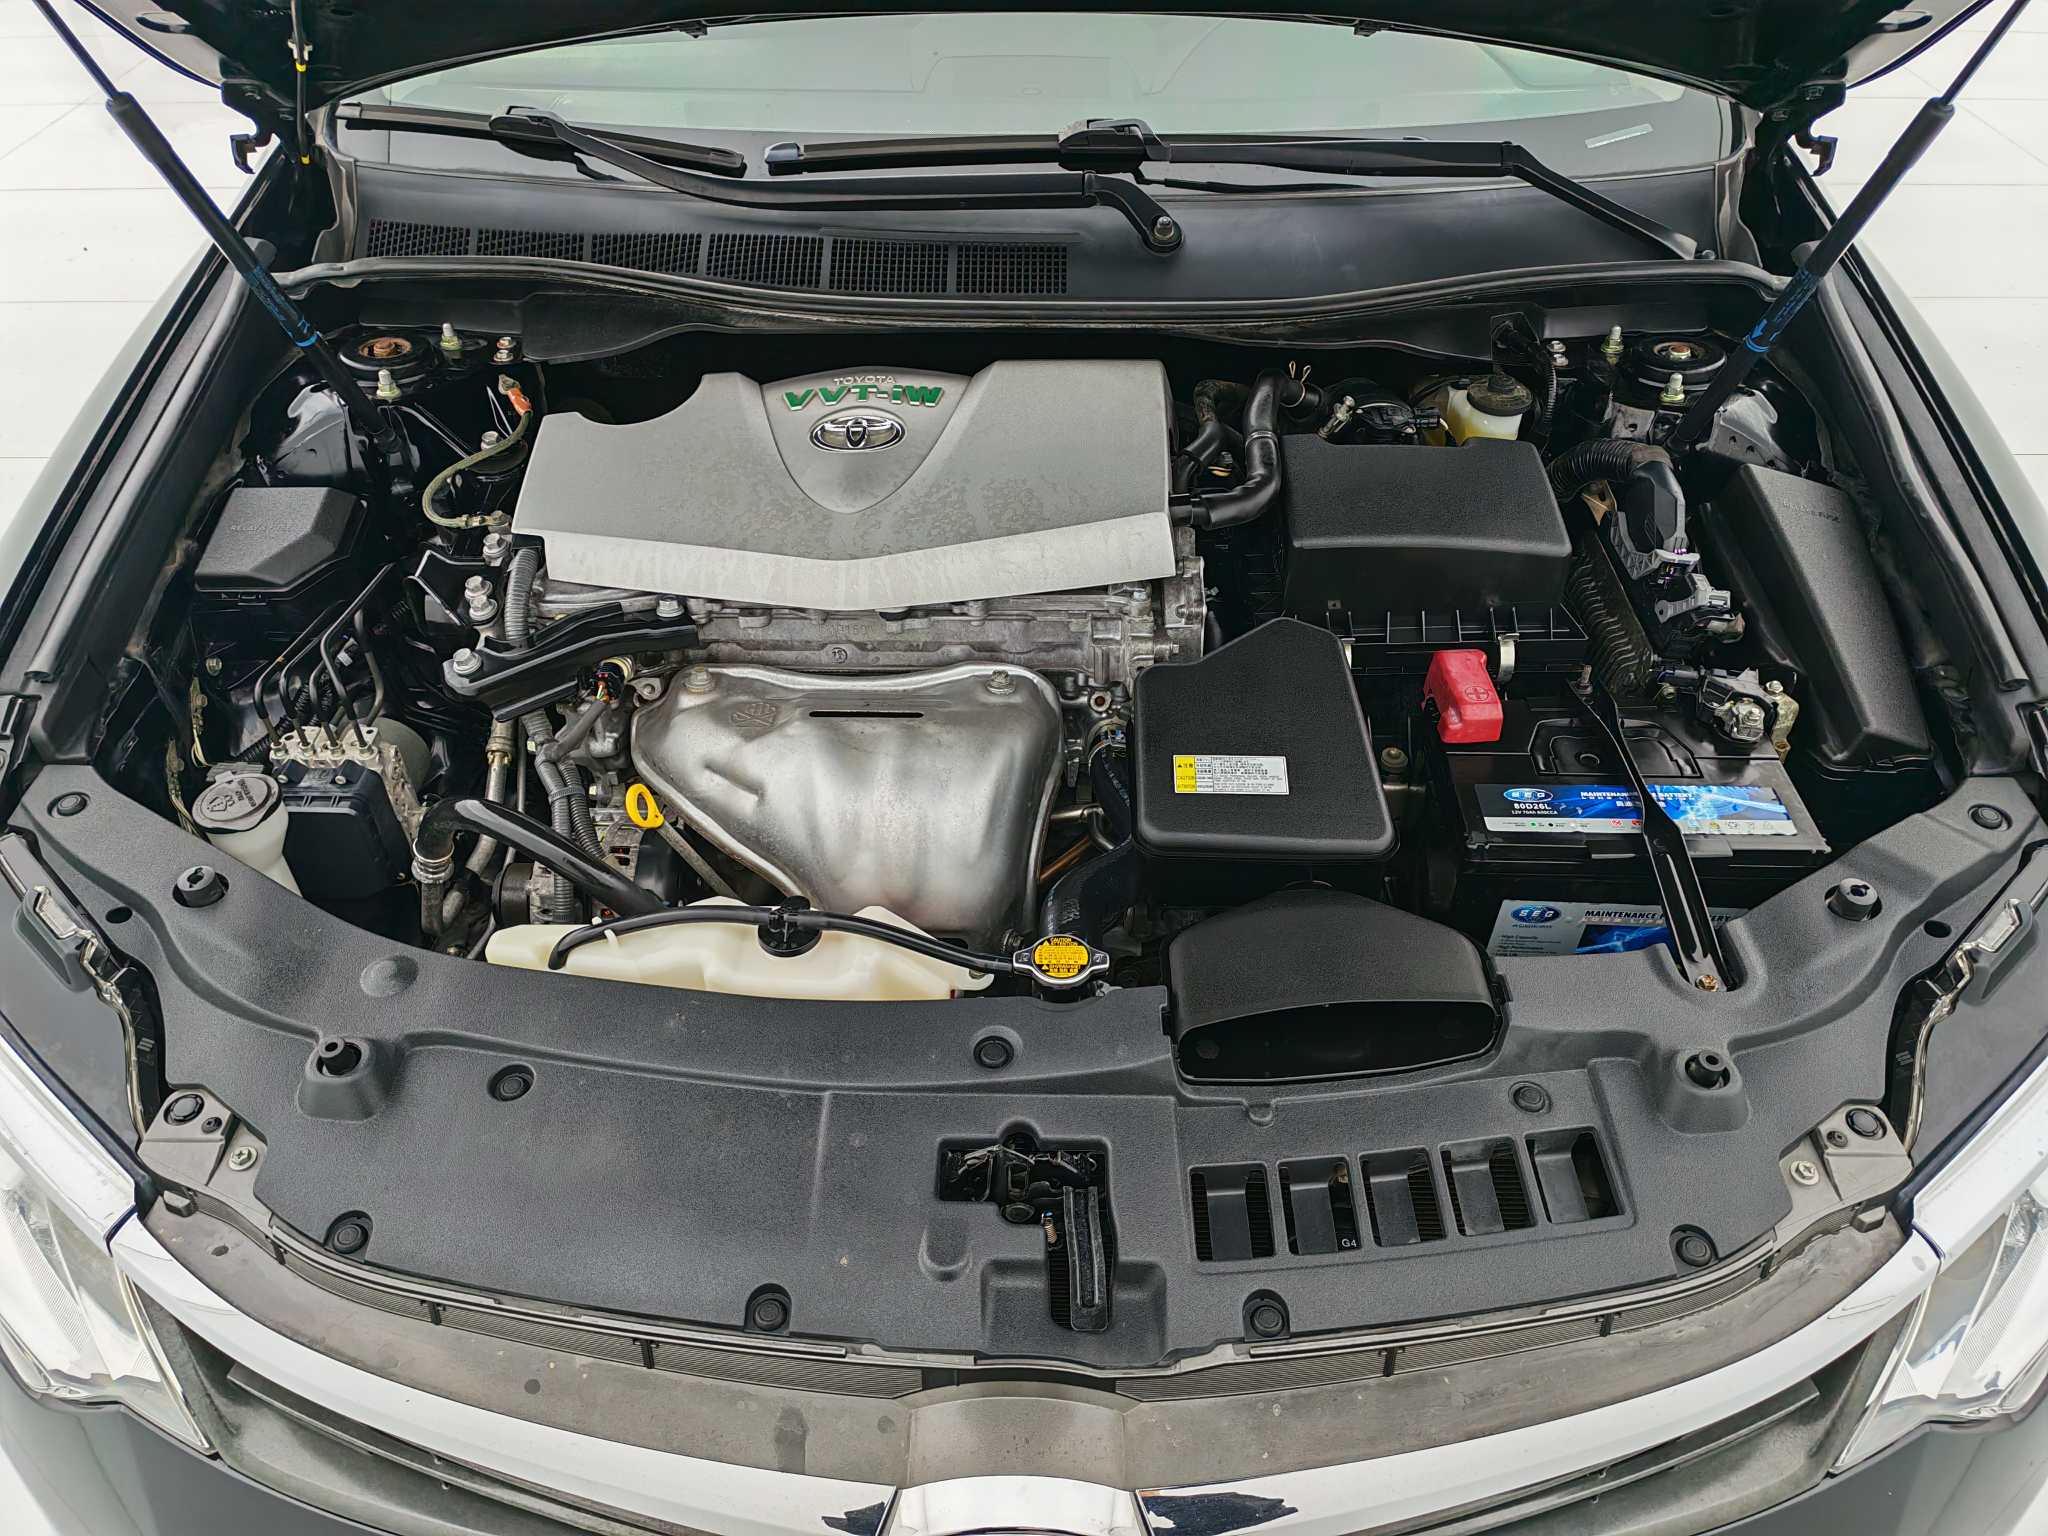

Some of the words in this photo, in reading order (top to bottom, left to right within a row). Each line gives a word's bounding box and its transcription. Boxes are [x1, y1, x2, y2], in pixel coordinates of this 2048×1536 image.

[833, 375, 896, 385] TOYOTA
[1584, 910, 1659, 919] MAINTENANCE
[1341, 1238, 1357, 1247] G4
